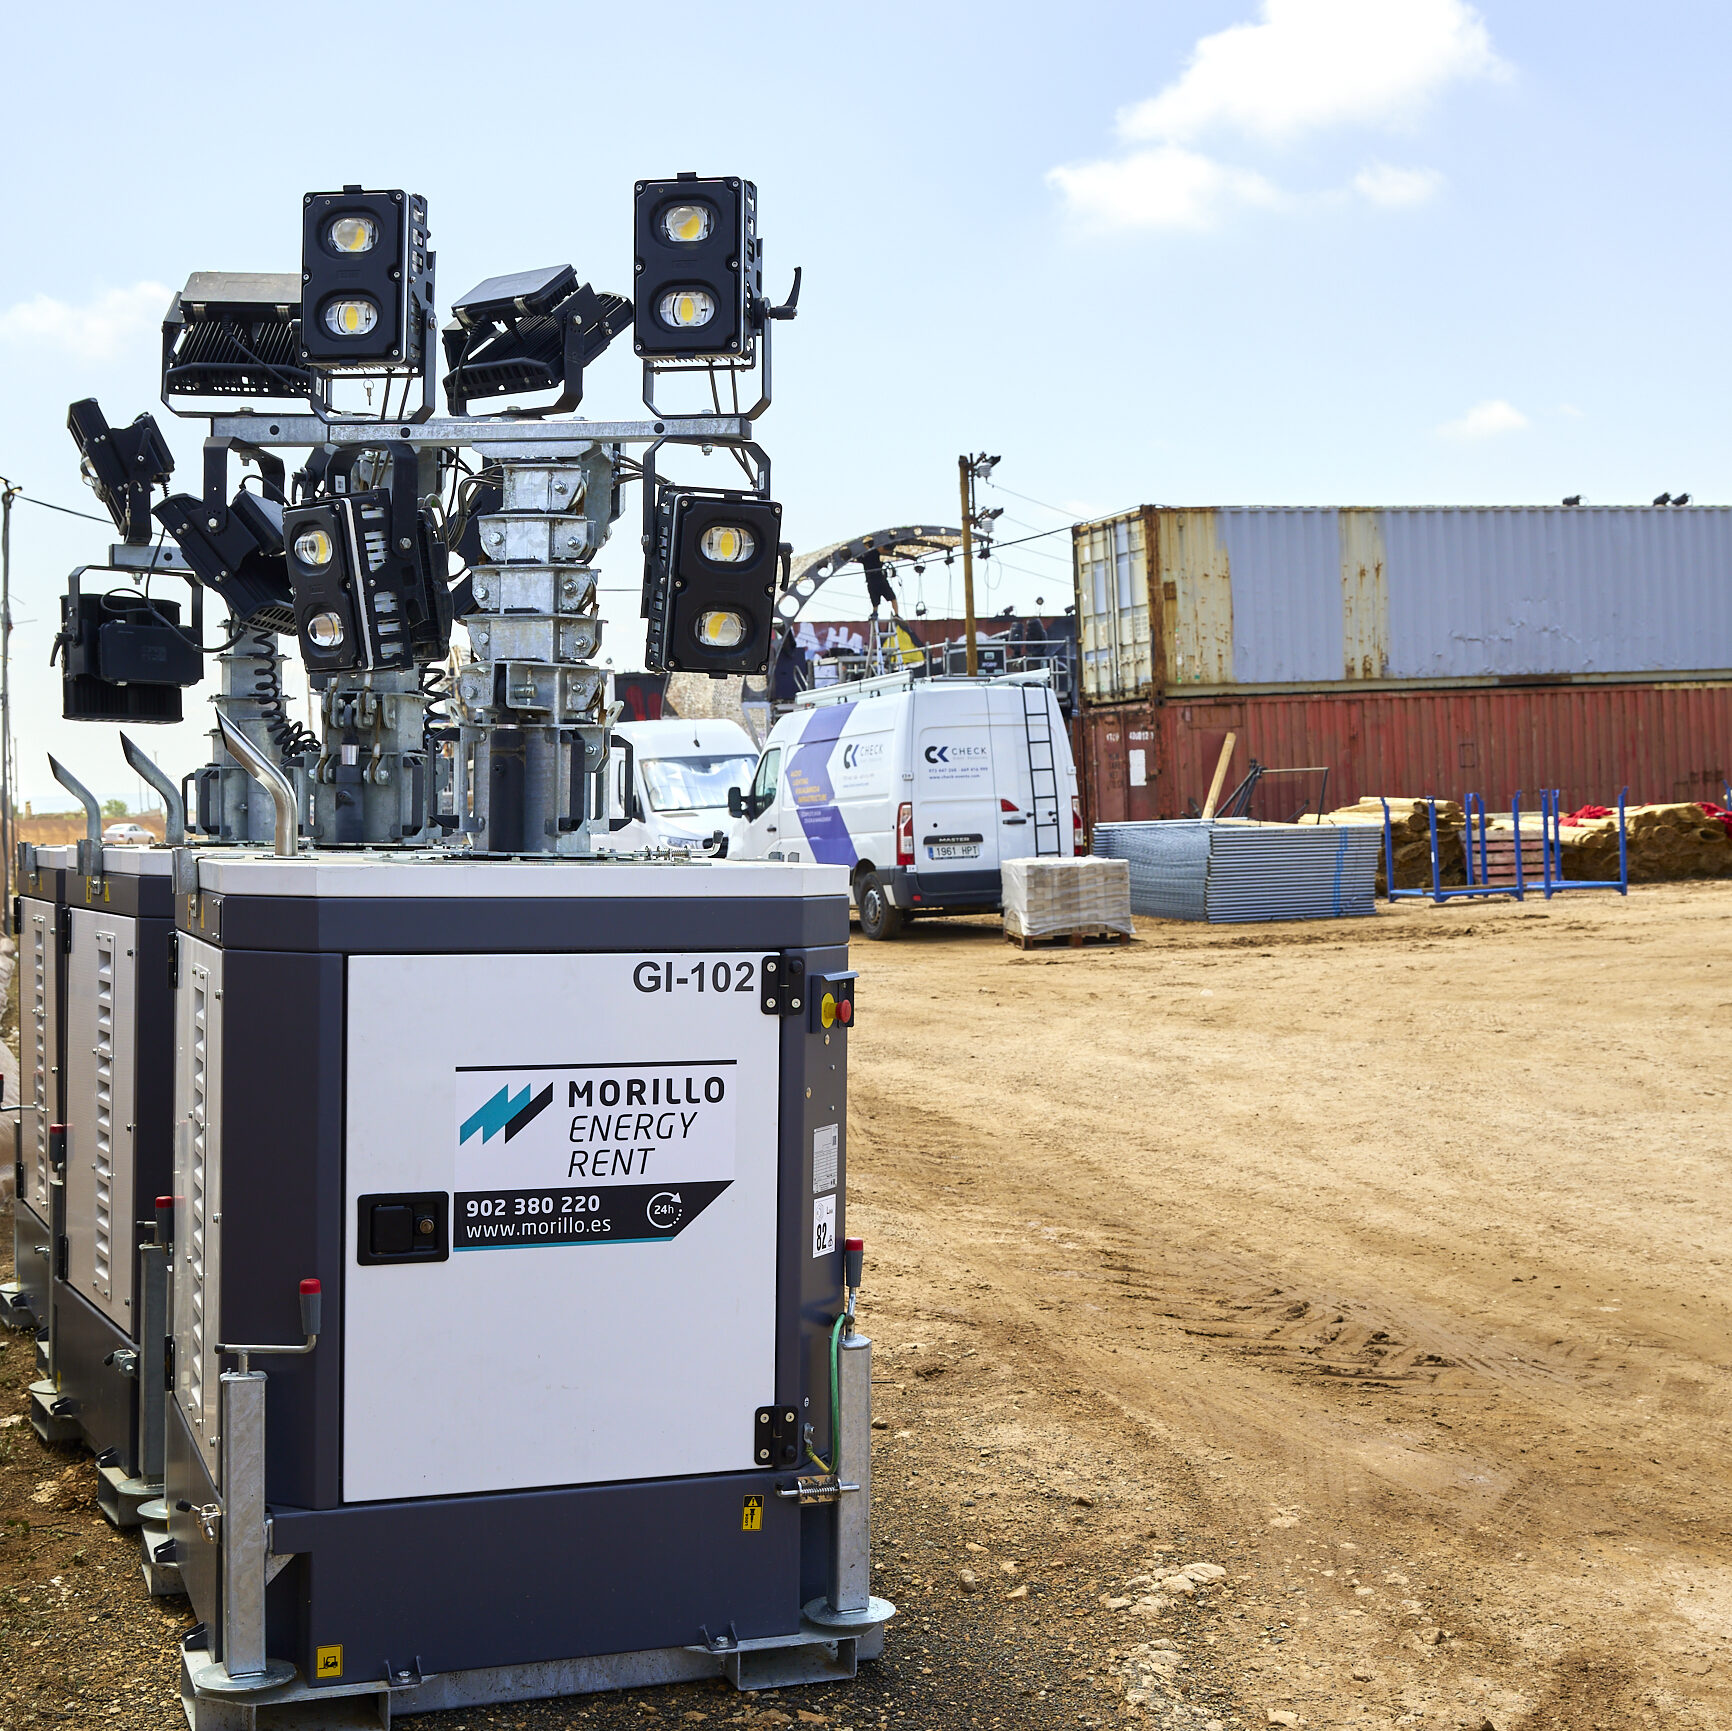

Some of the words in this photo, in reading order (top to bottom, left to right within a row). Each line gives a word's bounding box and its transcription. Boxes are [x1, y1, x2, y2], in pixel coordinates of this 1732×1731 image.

[951, 747, 987, 755] CHECK
[936, 846, 956, 856] 1961
[961, 845, 977, 855] HPT
[633, 961, 755, 993] GI-102
[568, 1076, 725, 1108] MORILLO
[569, 1111, 698, 1142] ENERGY
[567, 1147, 655, 1178] RENT
[466, 1200, 506, 1217] 902
[514, 1197, 554, 1216] 380
[561, 1195, 600, 1213] 220
[654, 1204, 675, 1215] 24h
[466, 1217, 612, 1239] www.morillo.es
[816, 1222, 828, 1251] 82
